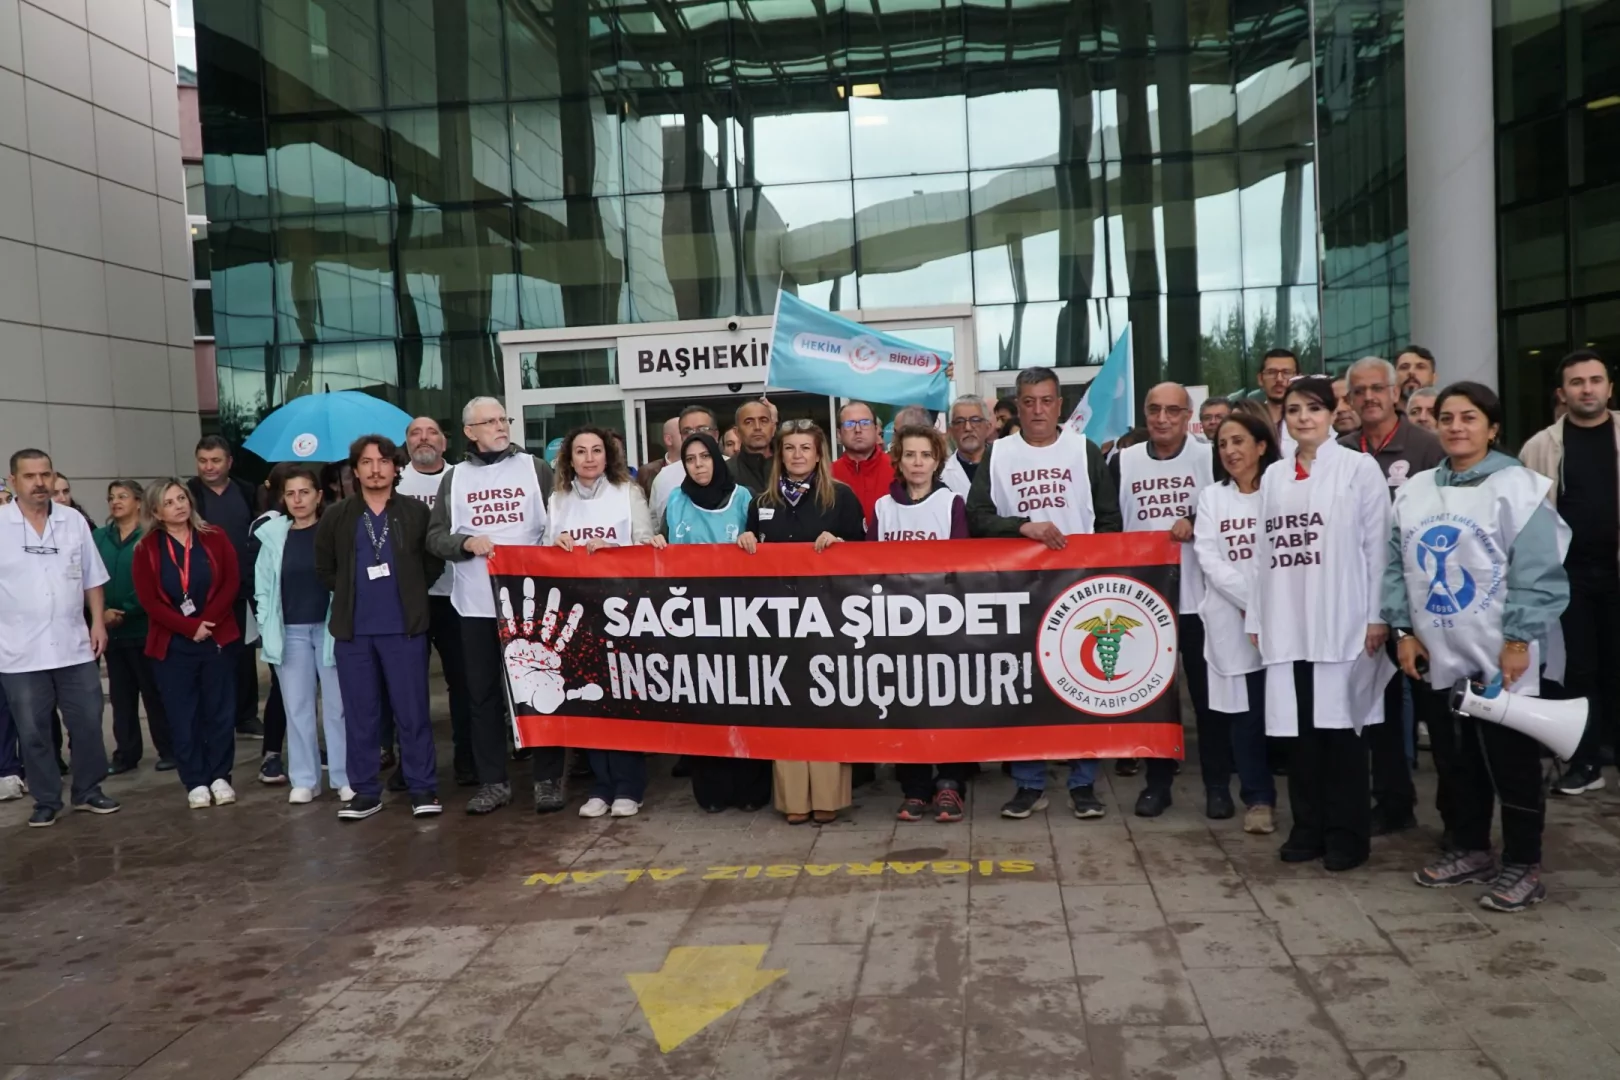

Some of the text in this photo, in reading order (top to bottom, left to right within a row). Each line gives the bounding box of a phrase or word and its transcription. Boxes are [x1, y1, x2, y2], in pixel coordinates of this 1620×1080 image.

[801, 338, 841, 354] HEKİM
[889, 352, 930, 368] BİRLİĞİ
[1011, 467, 1072, 486] BURSA
[1132, 475, 1196, 494] BURSA
[467, 487, 526, 504] BURSA
[1017, 480, 1066, 499] TABİP
[1137, 490, 1190, 507] TABİP
[472, 500, 521, 514] TABİP
[1017, 496, 1068, 513] ODAS
[1137, 505, 1193, 521] ODASI
[471, 512, 525, 527] ODASI
[1265, 512, 1324, 534] BURSA
[561, 526, 617, 541] URSA
[602, 584, 1031, 649] SAĞLIKTA ŞİDDET
[1047, 582, 1171, 632] TÜRK TABİPLERİ BİRLİĞİ
[606, 640, 1033, 720] İNSANLIK SUÇUDUR!
[1056, 673, 1164, 708] BURSA TABİP ODASI
[523, 867, 687, 886] ALAN
